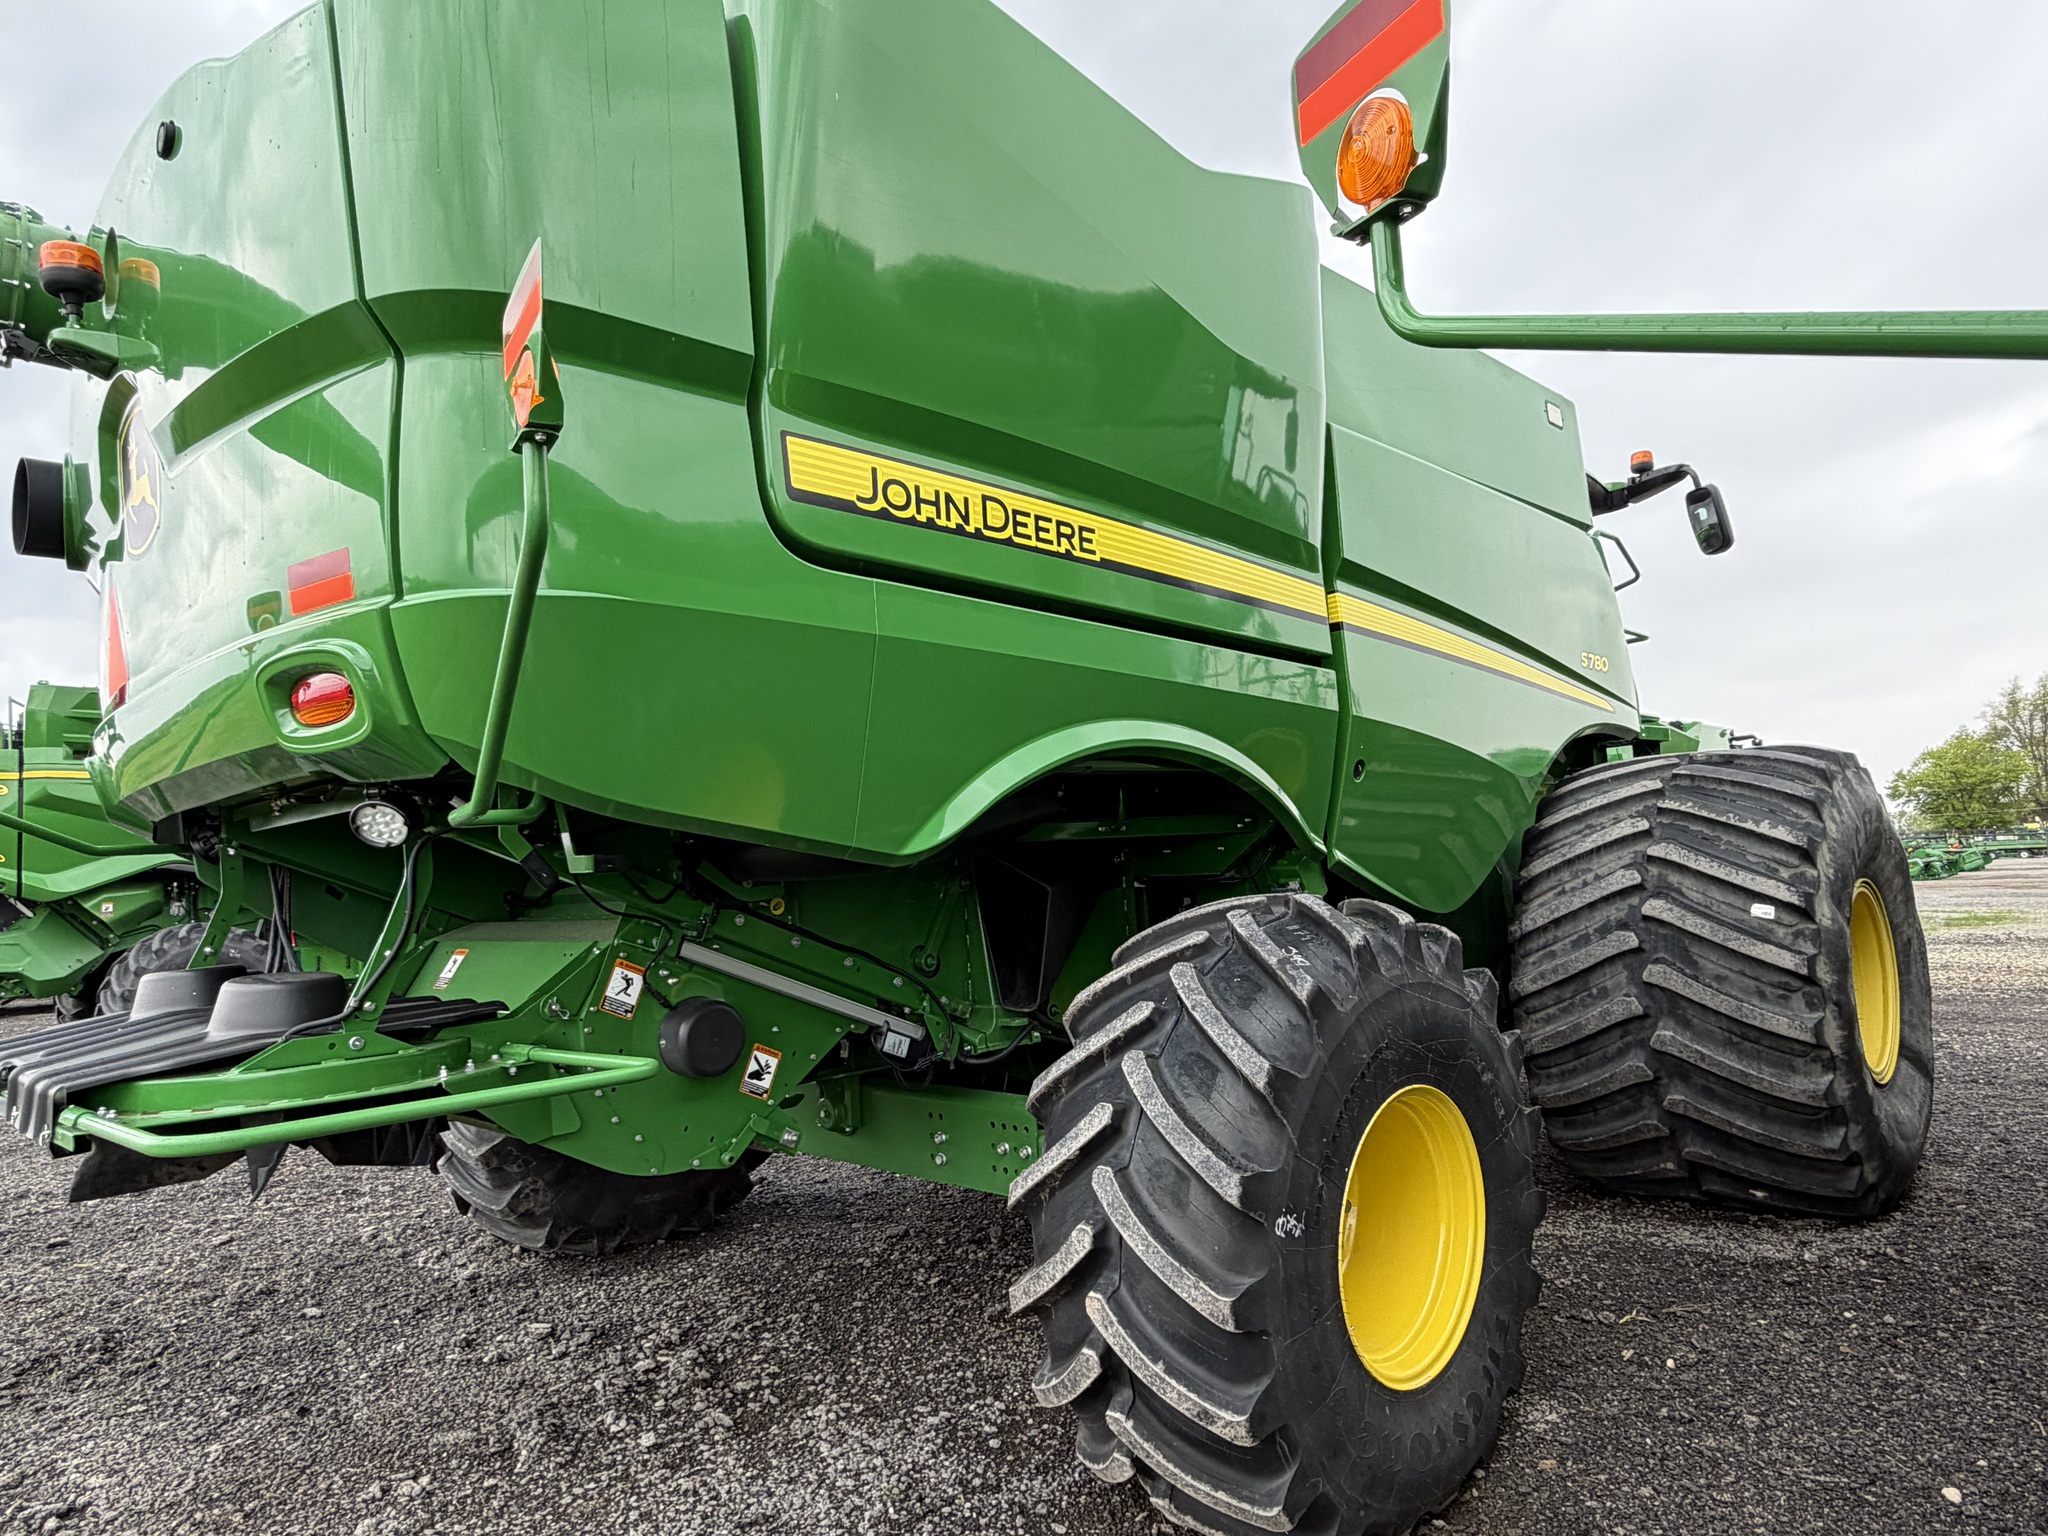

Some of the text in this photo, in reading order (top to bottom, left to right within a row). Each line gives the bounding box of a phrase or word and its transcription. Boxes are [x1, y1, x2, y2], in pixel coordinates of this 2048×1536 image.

[855, 466, 1098, 557] JOHN DEERE
[1580, 651, 1609, 672] S780
